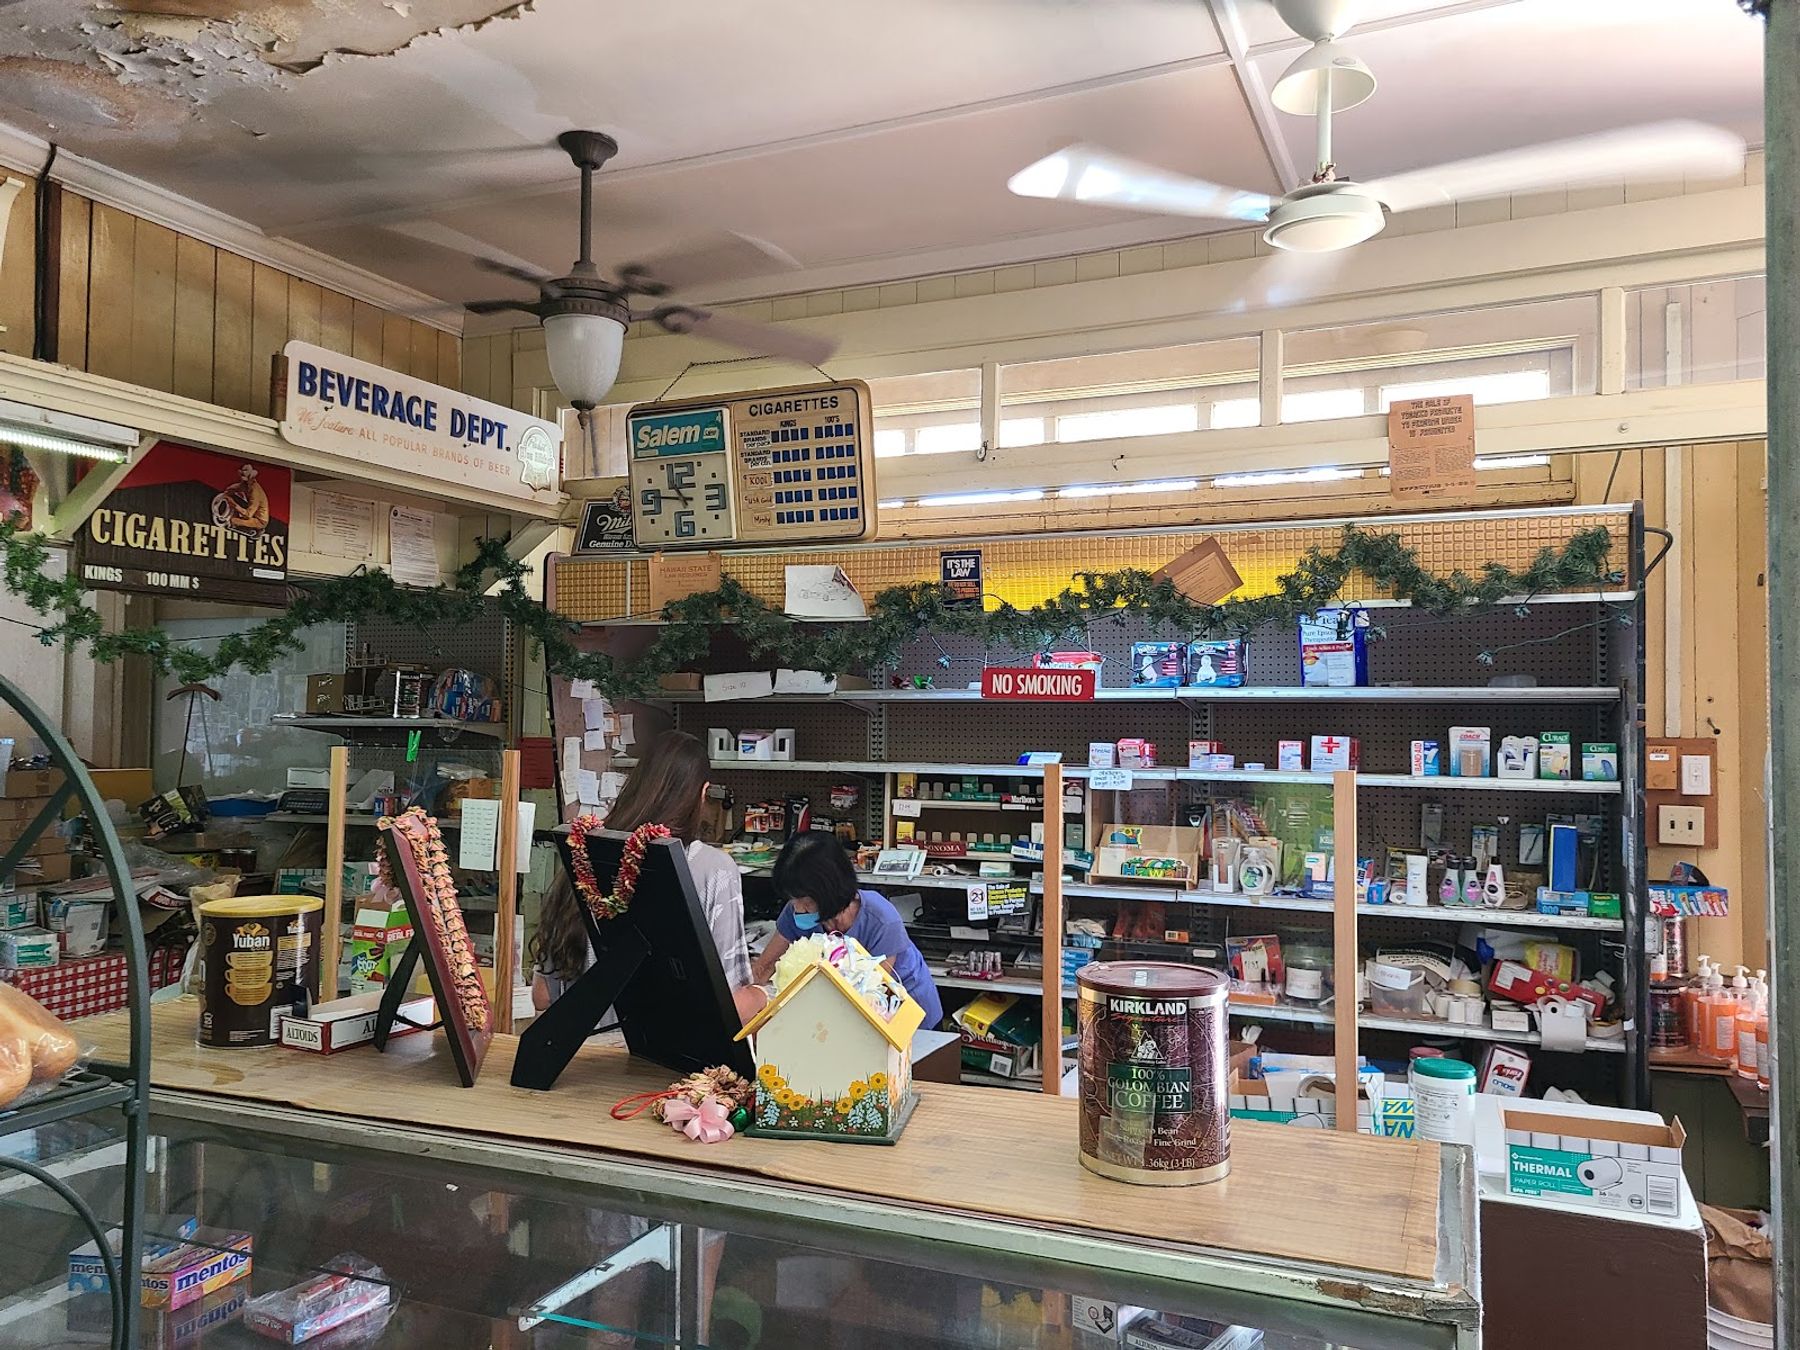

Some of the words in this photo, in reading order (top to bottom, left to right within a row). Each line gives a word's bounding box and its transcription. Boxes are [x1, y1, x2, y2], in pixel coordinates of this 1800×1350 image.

[298, 360, 437, 432] BEVERAGE
[450, 407, 511, 452] DEPT.
[749, 396, 839, 417] CIGARETTES
[637, 424, 700, 449] Salem
[740, 429, 771, 437] STANDARD
[297, 409, 315, 425] We
[312, 415, 354, 436] feature
[359, 427, 377, 442] ALL
[383, 434, 428, 455] POPULAR
[432, 446, 469, 465] BRANDS
[473, 458, 485, 468] OF
[488, 460, 511, 477] BEER
[740, 450, 771, 458] STANDARD
[705, 483, 726, 511] 3
[597, 514, 633, 532] Mil
[674, 510, 695, 537] 6
[91, 508, 285, 568] CIGARETTES
[589, 540, 624, 548] Genuine
[947, 559, 960, 569] IT'S
[961, 558, 976, 568] THE
[84, 564, 122, 582] KINGS
[146, 572, 168, 587] 100
[169, 574, 190, 589] MM
[951, 568, 971, 578] LAW
[992, 674, 1012, 695] NO
[1017, 674, 1083, 697] SMOKING
[1414, 742, 1422, 772] BAND-AID
[1012, 795, 1036, 804] Marlboro
[924, 844, 961, 853] SONOMA
[232, 933, 270, 949] Yuban
[1110, 998, 1187, 1015] KIRKLAND
[286, 1028, 318, 1043] ALTOIDS
[1131, 1068, 1165, 1080] 100%
[1108, 1077, 1190, 1094] COLOMBIAN
[1115, 1092, 1186, 1109] COFFEE
[1158, 1127, 1178, 1136] Bean
[1154, 1138, 1172, 1147] Fine
[1174, 1137, 1196, 1147] Grind
[1513, 1161, 1572, 1178] THERMAL
[1514, 1177, 1537, 1186] PAPER
[1538, 1180, 1556, 1189] ROLL
[71, 1263, 103, 1274] men
[177, 1246, 249, 1291] mentos
[141, 1278, 169, 1290] ntos
